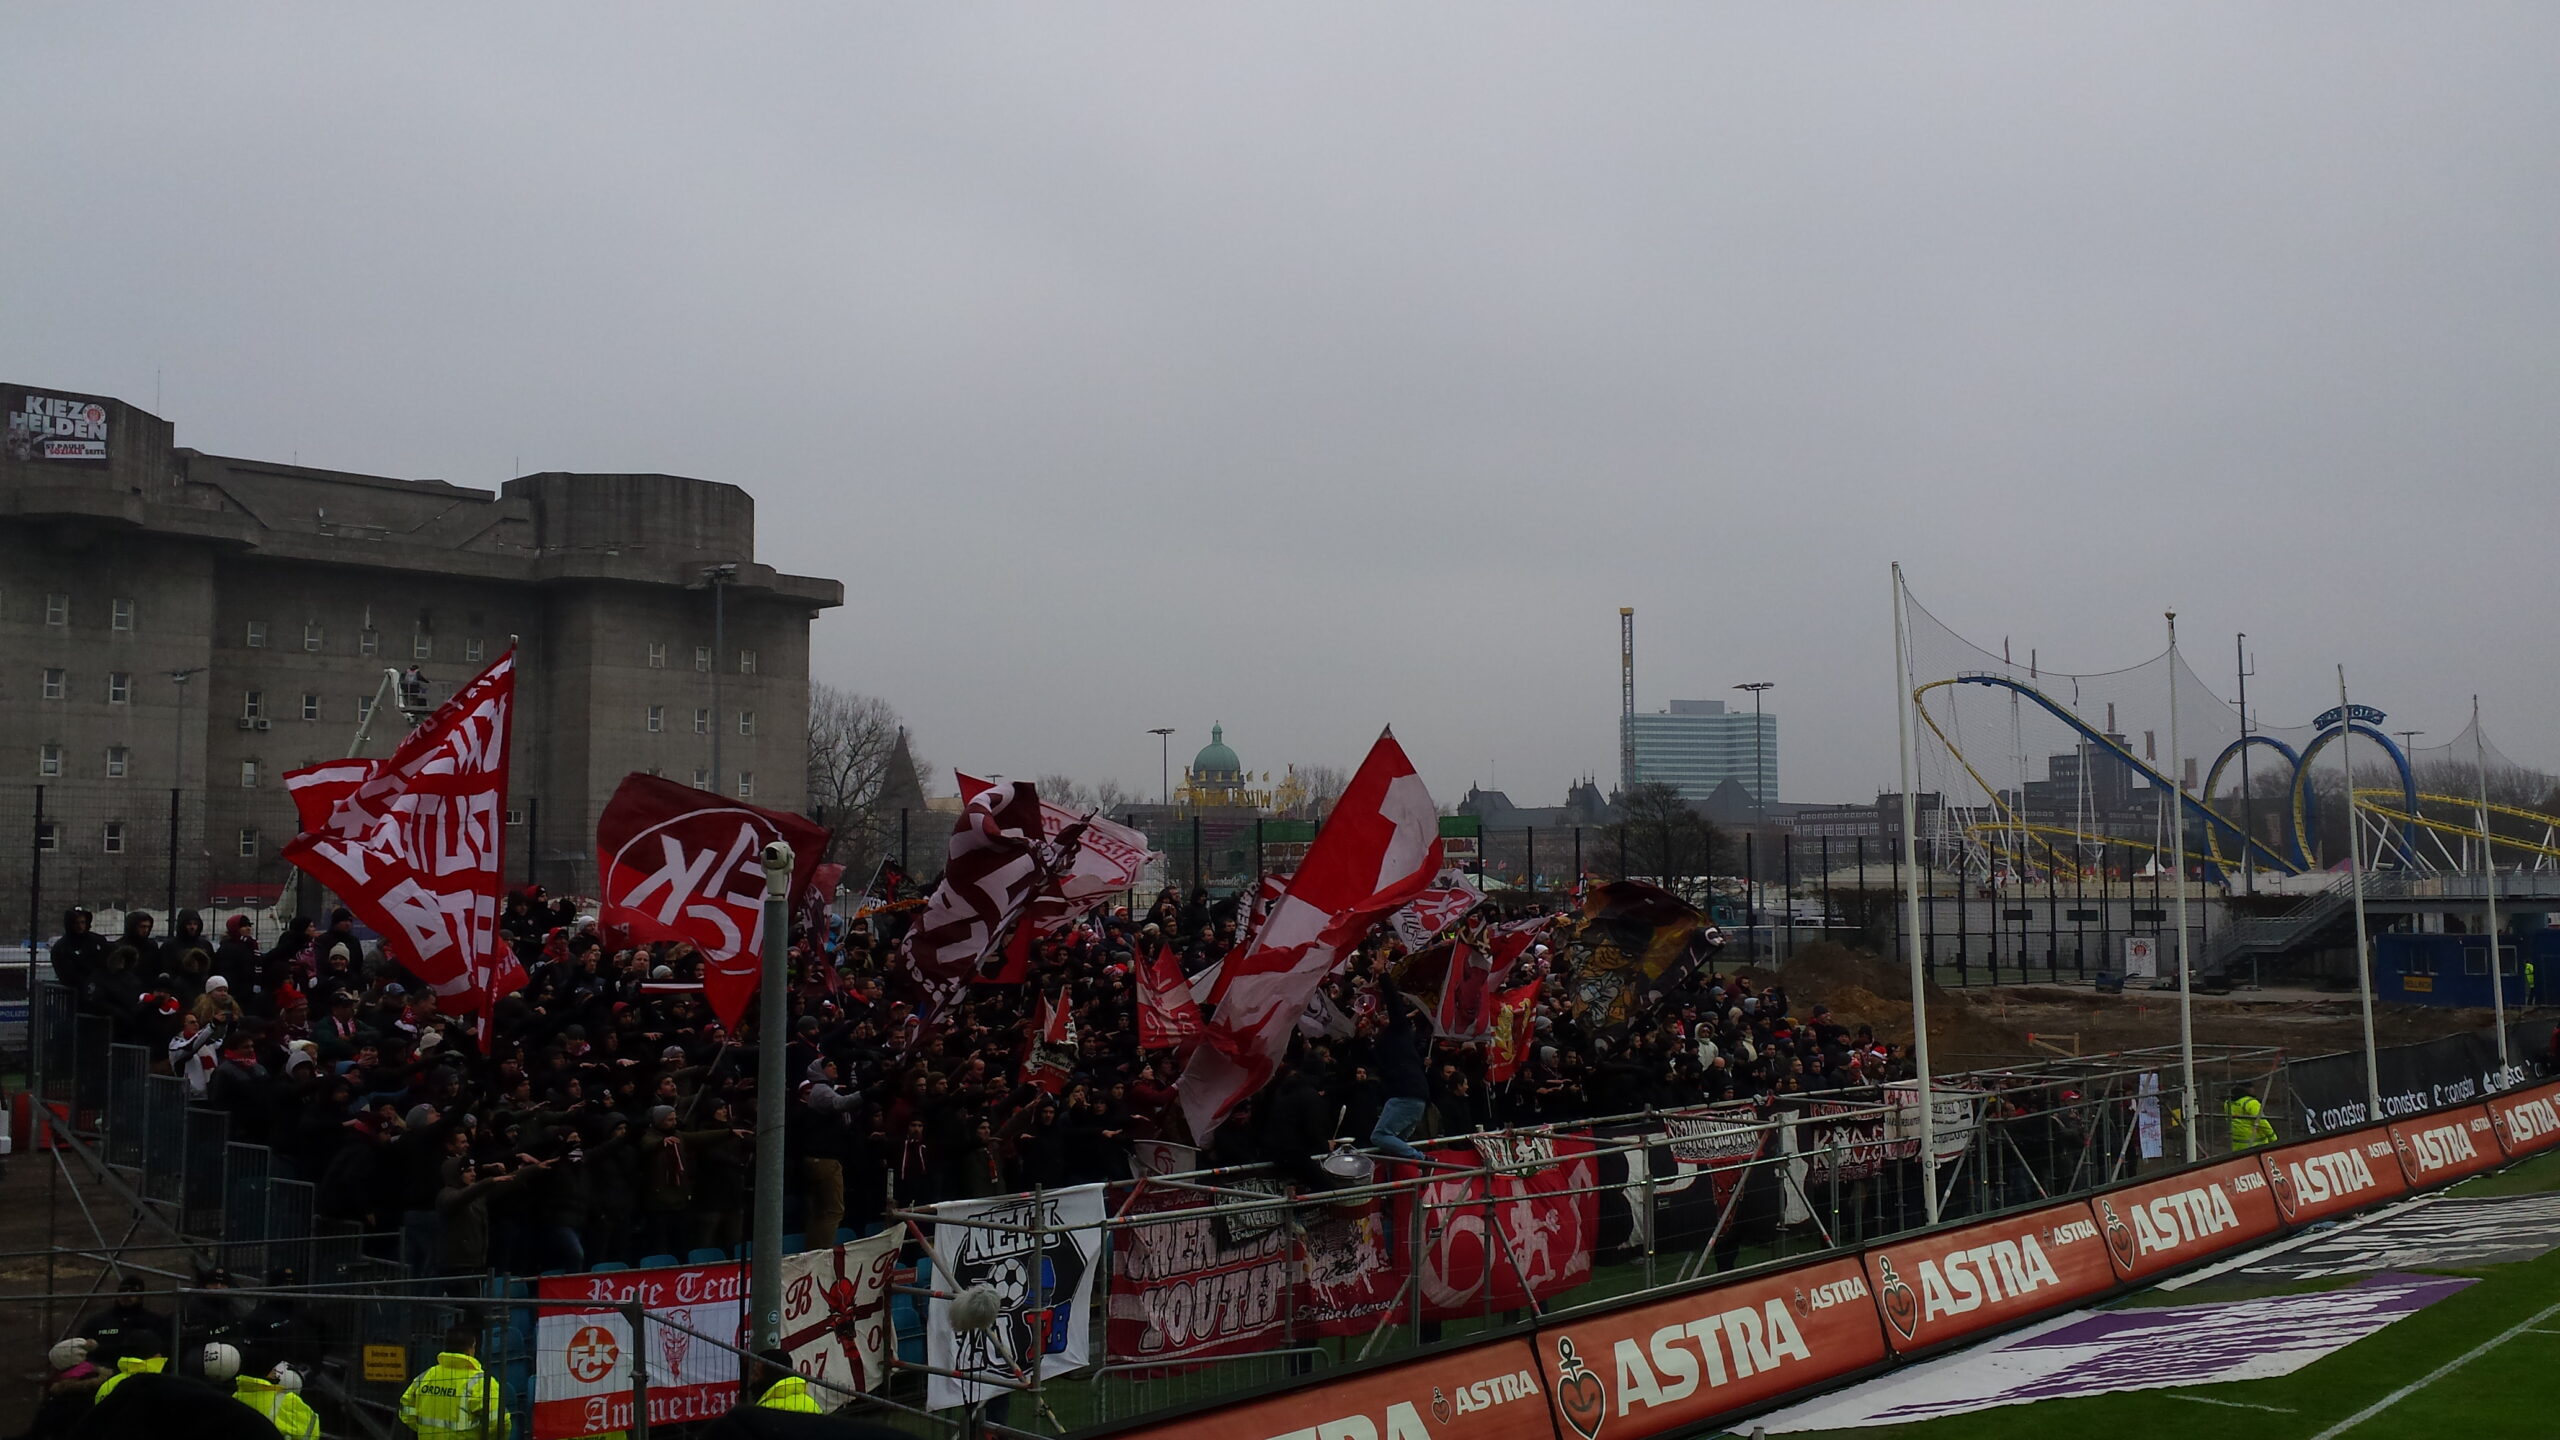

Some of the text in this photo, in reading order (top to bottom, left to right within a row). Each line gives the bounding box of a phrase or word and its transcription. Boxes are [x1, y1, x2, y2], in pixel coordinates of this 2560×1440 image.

[10, 411, 107, 441] HELDEN
[26, 395, 86, 421] KIEZ
[2470, 1115, 2492, 1133] ASTRA
[2504, 1097, 2560, 1145] ASTRA
[2368, 1140, 2394, 1158] ASTRA
[2411, 1123, 2479, 1173] ASTRA
[2233, 1171, 2267, 1195] ASTRA
[2289, 1148, 2376, 1207] ASTRA
[2053, 1218, 2098, 1248] ASTRA
[2129, 1182, 2240, 1257] ASTRA
[585, 1277, 664, 1313] Rote
[1810, 1275, 1868, 1313] ASTRA
[1917, 1233, 2061, 1323] ASTRA
[1139, 1260, 1284, 1353] YOUTH
[1613, 1296, 1812, 1418] ASTRA
[1455, 1369, 1540, 1416] ASTRA
